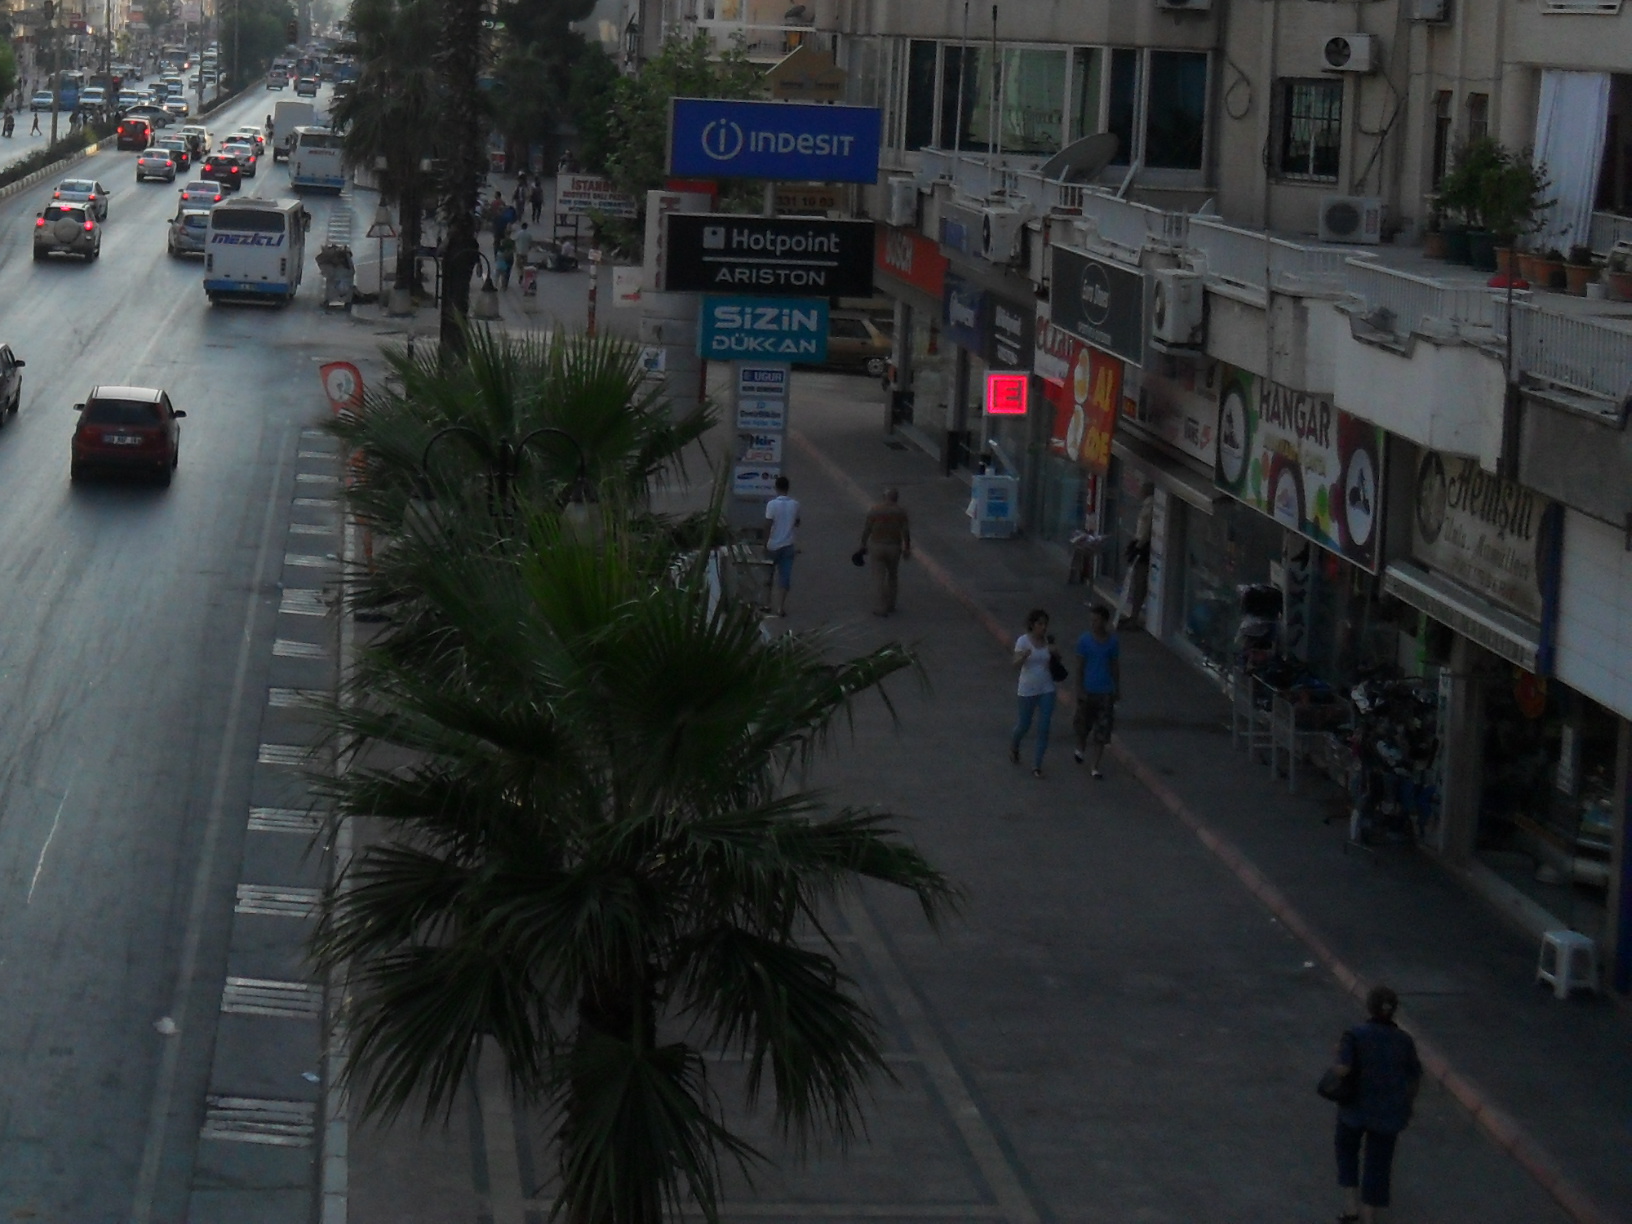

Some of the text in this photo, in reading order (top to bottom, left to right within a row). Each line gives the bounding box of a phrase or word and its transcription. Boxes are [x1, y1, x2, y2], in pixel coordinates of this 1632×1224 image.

[750, 130, 854, 157] INDESIT
[732, 228, 840, 256] Hotpoint
[715, 267, 826, 286] ARISTON
[712, 333, 817, 353] DÜKKAN
[1259, 377, 1331, 449] HANGAR
